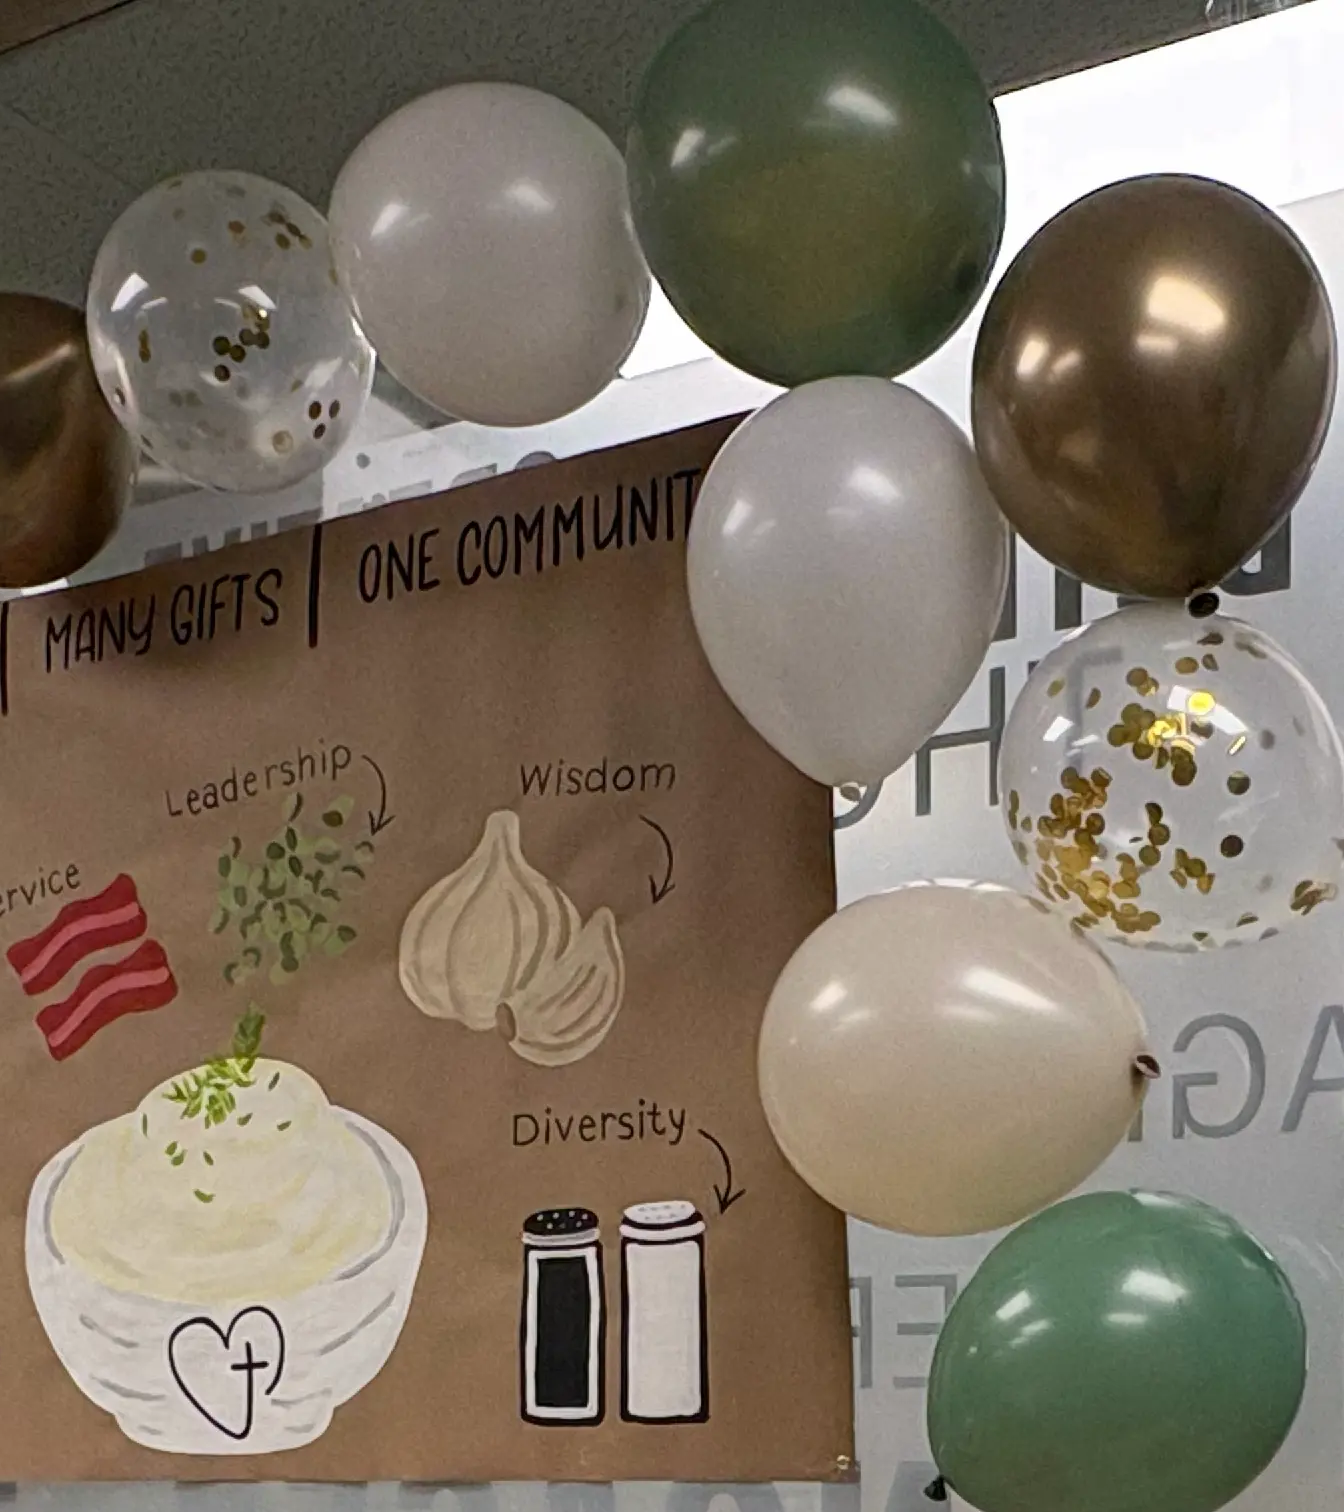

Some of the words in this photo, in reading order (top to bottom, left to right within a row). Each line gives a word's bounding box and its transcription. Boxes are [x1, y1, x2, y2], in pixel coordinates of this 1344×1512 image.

[44, 595, 156, 674] MANY
[170, 567, 284, 647] GIFTS
[358, 528, 442, 604] ONE
[457, 467, 703, 587] COMMUNIT
[164, 737, 353, 819] Leadership
[519, 756, 677, 798] Wisdom
[511, 1098, 685, 1147] Diversity
